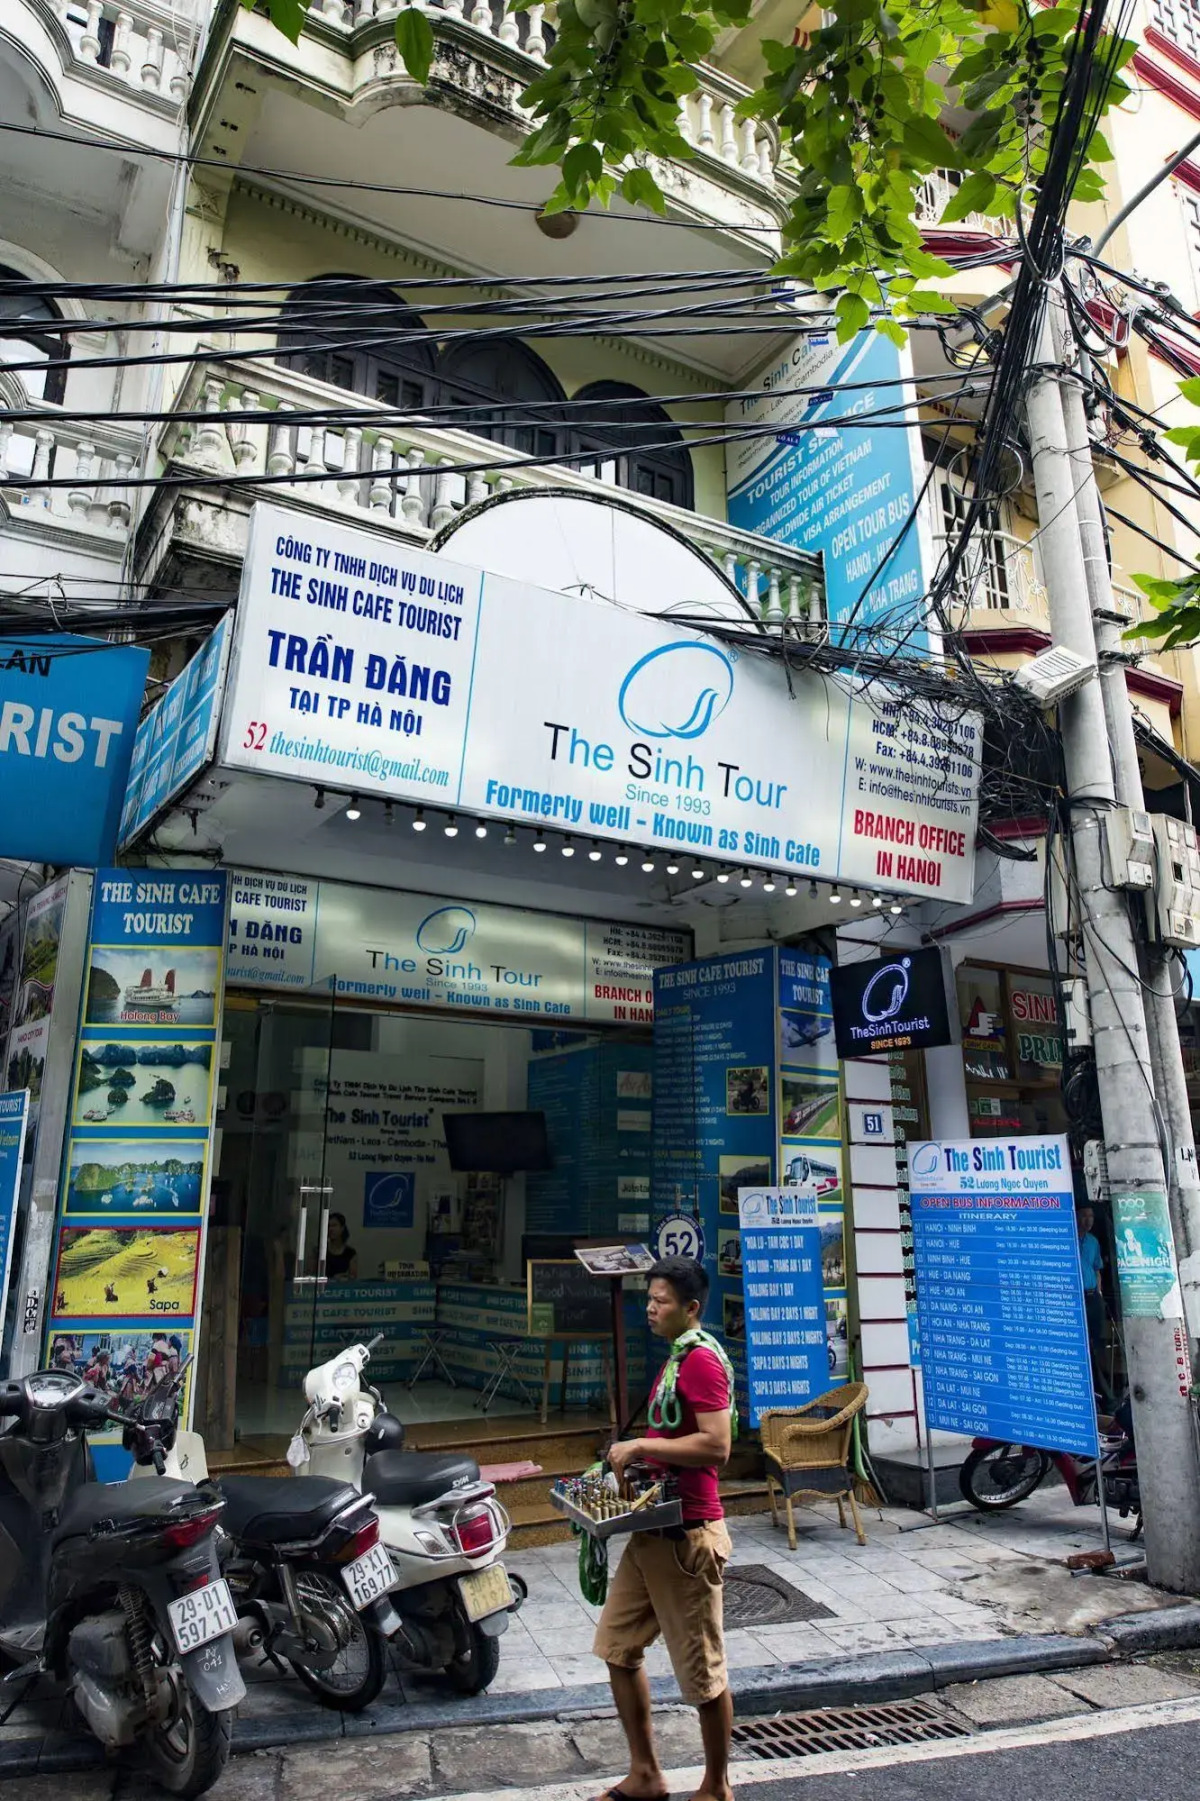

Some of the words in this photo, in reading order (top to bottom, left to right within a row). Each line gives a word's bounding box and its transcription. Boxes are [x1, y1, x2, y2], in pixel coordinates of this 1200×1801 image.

[763, 361, 788, 392] Sinh
[746, 447, 805, 505] TOURIST
[770, 484, 790, 506] TOUR
[790, 437, 843, 496] INFORMATION
[797, 484, 819, 504] TOUR
[820, 473, 831, 487] OF
[832, 438, 873, 476] VIETNAM
[803, 521, 822, 542] VISA
[823, 472, 891, 523] ARRANGEMENT
[811, 498, 824, 517] AIR
[825, 473, 855, 505] TICKET
[831, 529, 857, 558] OPEN
[857, 509, 886, 540] TOUR
[888, 493, 911, 521] BUS
[276, 535, 312, 564] CÔNG
[316, 547, 331, 568] TY
[334, 552, 367, 579] TNHH
[369, 562, 399, 588] DỊCH
[401, 570, 417, 596] VỤ
[419, 576, 435, 597] DU
[438, 582, 465, 605] LỊCH
[845, 555, 872, 583] HANOI
[888, 568, 918, 601] TRANG
[271, 567, 303, 600] THE
[306, 578, 349, 611] SINH
[352, 590, 394, 624] CAFE
[398, 601, 463, 641] TOURIST
[0, 648, 52, 677] AN
[268, 629, 355, 684] TRẦN
[364, 654, 452, 707] ĐĂNG
[289, 687, 320, 715] TẠI
[327, 695, 351, 719] TP
[356, 702, 382, 727] HÀ
[389, 709, 423, 737] NỘI
[243, 721, 268, 751] 52
[269, 731, 451, 787] thesinhtourist@gmail.com
[876, 741, 897, 759] Fax:
[544, 721, 614, 772] The
[628, 743, 704, 793] Sinh
[718, 761, 789, 809] Tour
[855, 757, 867, 772] W:
[858, 777, 867, 791] E:
[625, 784, 670, 808] Since
[675, 793, 712, 816] 1993
[485, 779, 585, 823] Formerly
[589, 802, 632, 831] well
[652, 812, 716, 847] Known
[718, 832, 740, 852] as
[743, 830, 783, 859] Sinh
[785, 839, 823, 867] Cafe
[854, 809, 914, 846] BRANCH
[919, 824, 966, 858] OFFICE
[876, 850, 893, 878] IN
[897, 857, 942, 887] HANOI
[101, 882, 133, 903] THE
[136, 883, 176, 904] SINH
[178, 883, 220, 905] CAFE
[235, 890, 261, 907] CAFE
[264, 894, 307, 912] TOURIST
[277, 882, 289, 895] DU
[123, 913, 194, 935] TOURIST
[245, 920, 303, 945] ĐĂNG
[242, 944, 258, 957] HÀ
[263, 946, 285, 960] NỘI
[607, 947, 624, 957] Fax:
[366, 950, 416, 973] The
[426, 958, 481, 982] Sinh
[490, 966, 543, 988] Tour
[659, 973, 675, 989] THE
[676, 968, 698, 986] SINH
[698, 965, 722, 984] CAFE
[723, 958, 764, 980] TOURIST
[779, 960, 796, 977] THE
[796, 961, 814, 979] SINH
[329, 977, 400, 998] Formerly
[401, 986, 431, 1000] well
[447, 991, 491, 1008] Known
[496, 997, 509, 1009] as
[512, 997, 541, 1012] Sinh
[544, 1000, 571, 1015] Cafe
[426, 977, 460, 990] Since
[462, 981, 489, 994] 1993
[594, 984, 641, 1004] BRANCH
[682, 986, 712, 1001] SINCE
[713, 982, 737, 997] 1993
[792, 985, 824, 1006] TOURIST
[121, 1010, 157, 1025] Halong
[159, 1010, 180, 1025] Bay
[614, 1005, 626, 1020] IN
[850, 1015, 930, 1040] TheSinhTourist
[870, 1037, 895, 1050] SINCE
[351, 1109, 379, 1125] Sinh
[382, 1110, 430, 1128] Tourist
[867, 1115, 880, 1133] 51
[944, 1147, 969, 1172] The
[972, 1145, 1005, 1172] Sinh
[1007, 1143, 1062, 1170] Tourist
[960, 1176, 975, 1190] 52
[1001, 1177, 1021, 1191] Ngoc
[1023, 1177, 1049, 1192] Quyen
[766, 1195, 778, 1215] The
[778, 1195, 794, 1215] Sinh
[794, 1194, 816, 1215] Tourist
[920, 1197, 951, 1209] OPEN
[953, 1197, 973, 1209] BUS
[975, 1196, 1060, 1210] INFORMATION
[959, 1212, 1018, 1221] ITINERARY
[665, 1231, 694, 1257] 52
[353, 1288, 398, 1298] TOURIST
[149, 1299, 180, 1313] Sapa
[353, 1306, 398, 1317] TOURIST
[452, 1475, 469, 1489] SYM
[349, 1548, 384, 1586] 29-X1
[353, 1564, 394, 1603] 169.77
[177, 1586, 222, 1624] 29-D1
[178, 1605, 233, 1648] 597.11
